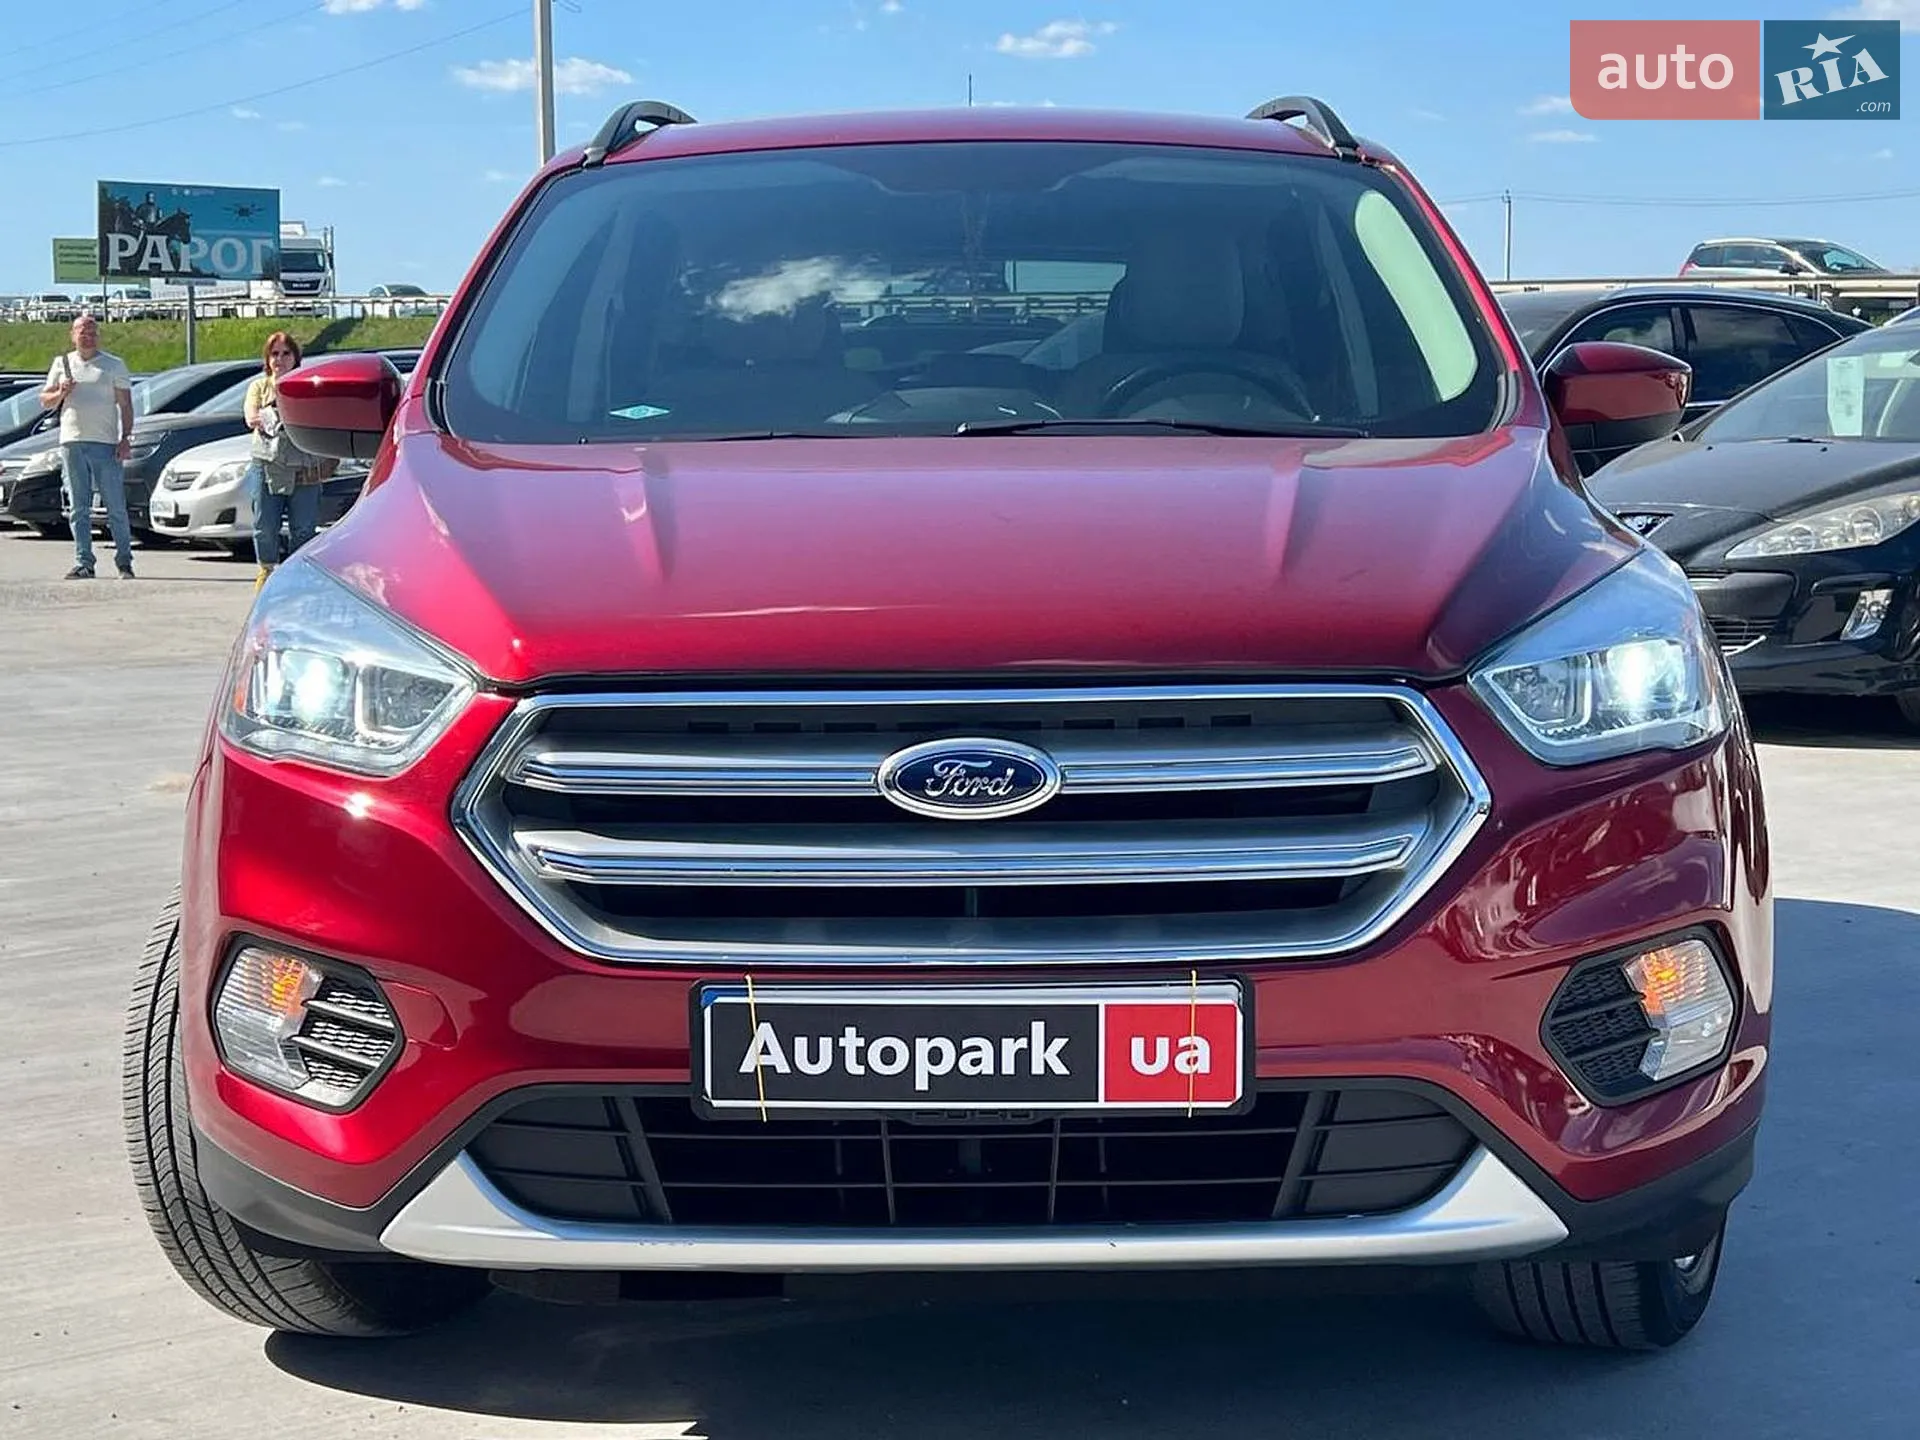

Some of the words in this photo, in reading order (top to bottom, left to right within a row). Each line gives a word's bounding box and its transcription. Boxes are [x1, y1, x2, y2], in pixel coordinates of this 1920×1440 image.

[924, 759, 1015, 797] Ford
[739, 1020, 1070, 1091] Autopark
[1130, 1034, 1211, 1075] ua
